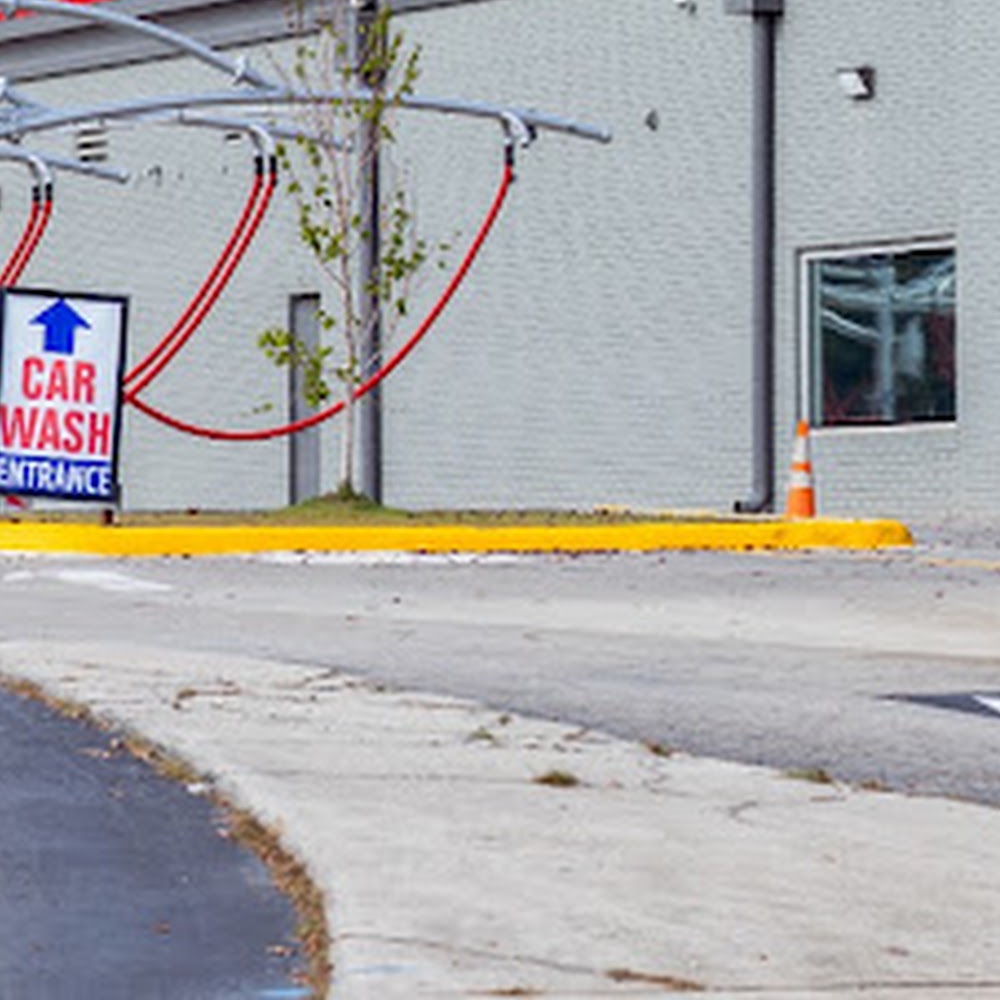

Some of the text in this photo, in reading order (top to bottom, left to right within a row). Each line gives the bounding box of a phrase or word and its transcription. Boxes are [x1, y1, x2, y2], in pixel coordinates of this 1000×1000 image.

[21, 356, 96, 404] CAR
[0, 403, 110, 456] WASH
[0, 457, 111, 495] ENTRANCE
